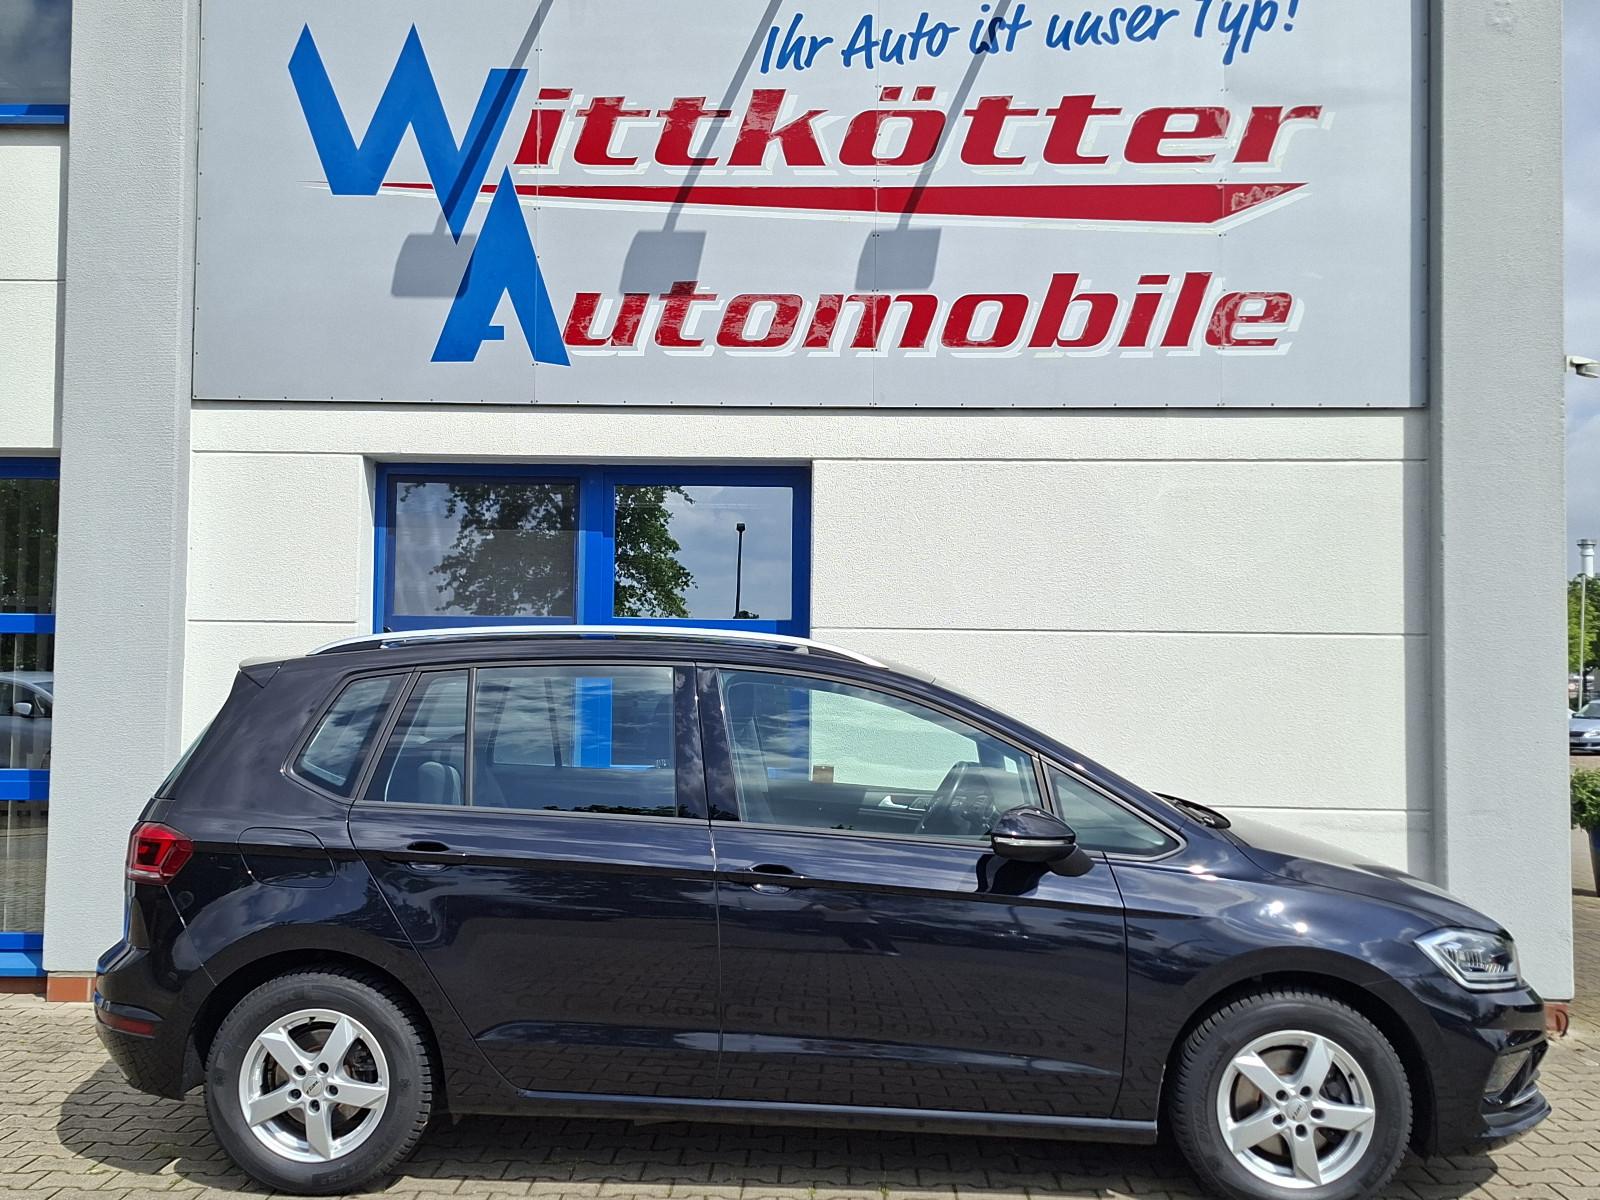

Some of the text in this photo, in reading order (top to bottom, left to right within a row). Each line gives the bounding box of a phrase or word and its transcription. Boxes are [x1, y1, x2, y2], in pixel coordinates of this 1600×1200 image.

[288, 24, 1320, 245] Wittkötter
[761, 0, 1298, 73] Ihr Auto ist unser Typ!
[431, 166, 1298, 366] Automobile
